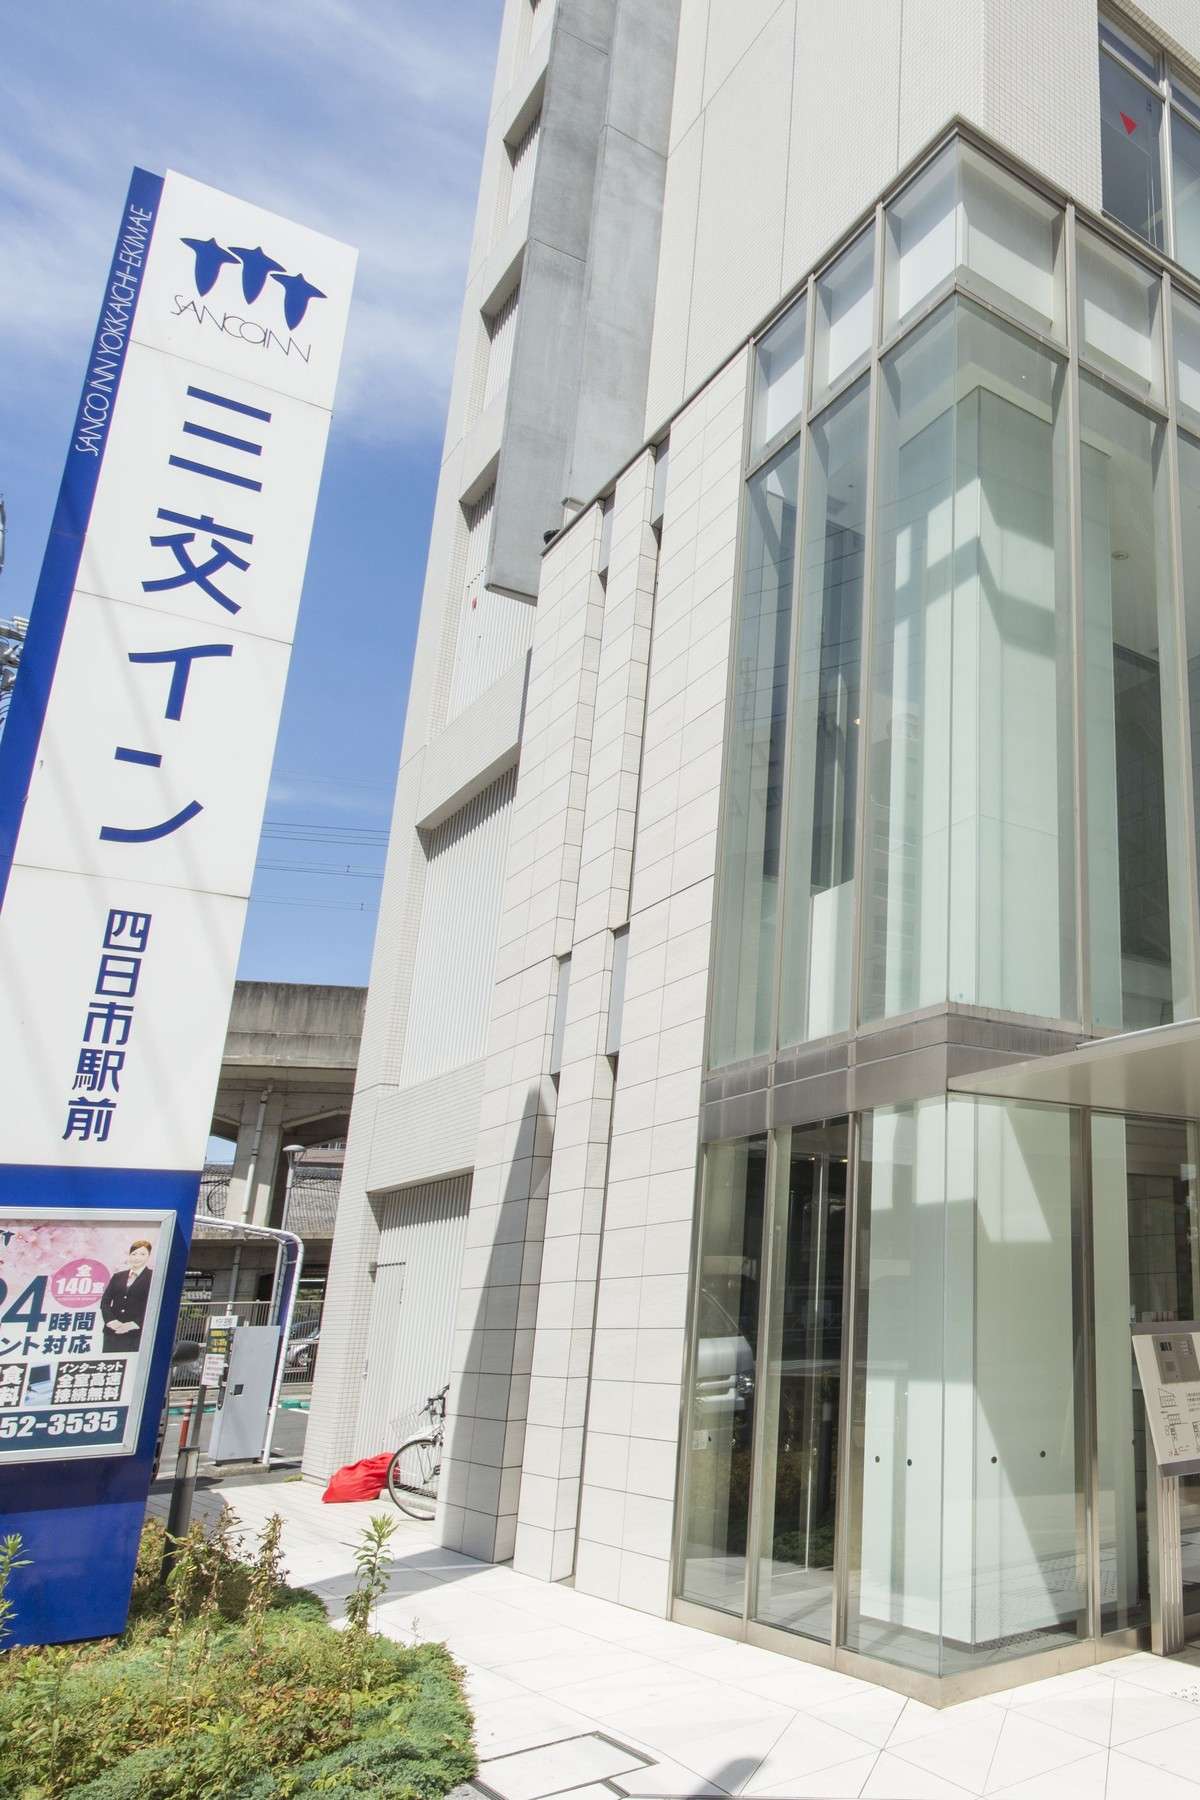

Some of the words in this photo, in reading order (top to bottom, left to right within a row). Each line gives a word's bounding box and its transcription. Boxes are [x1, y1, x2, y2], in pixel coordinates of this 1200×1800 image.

[97, 203, 153, 358] YOKKAICHI-EKIMAE
[74, 393, 111, 457] SANCO
[89, 357, 118, 393] INN
[99, 385, 272, 843] 三交イン
[61, 908, 152, 1142] 四日市駅前
[59, 1361, 123, 1374] インターネット
